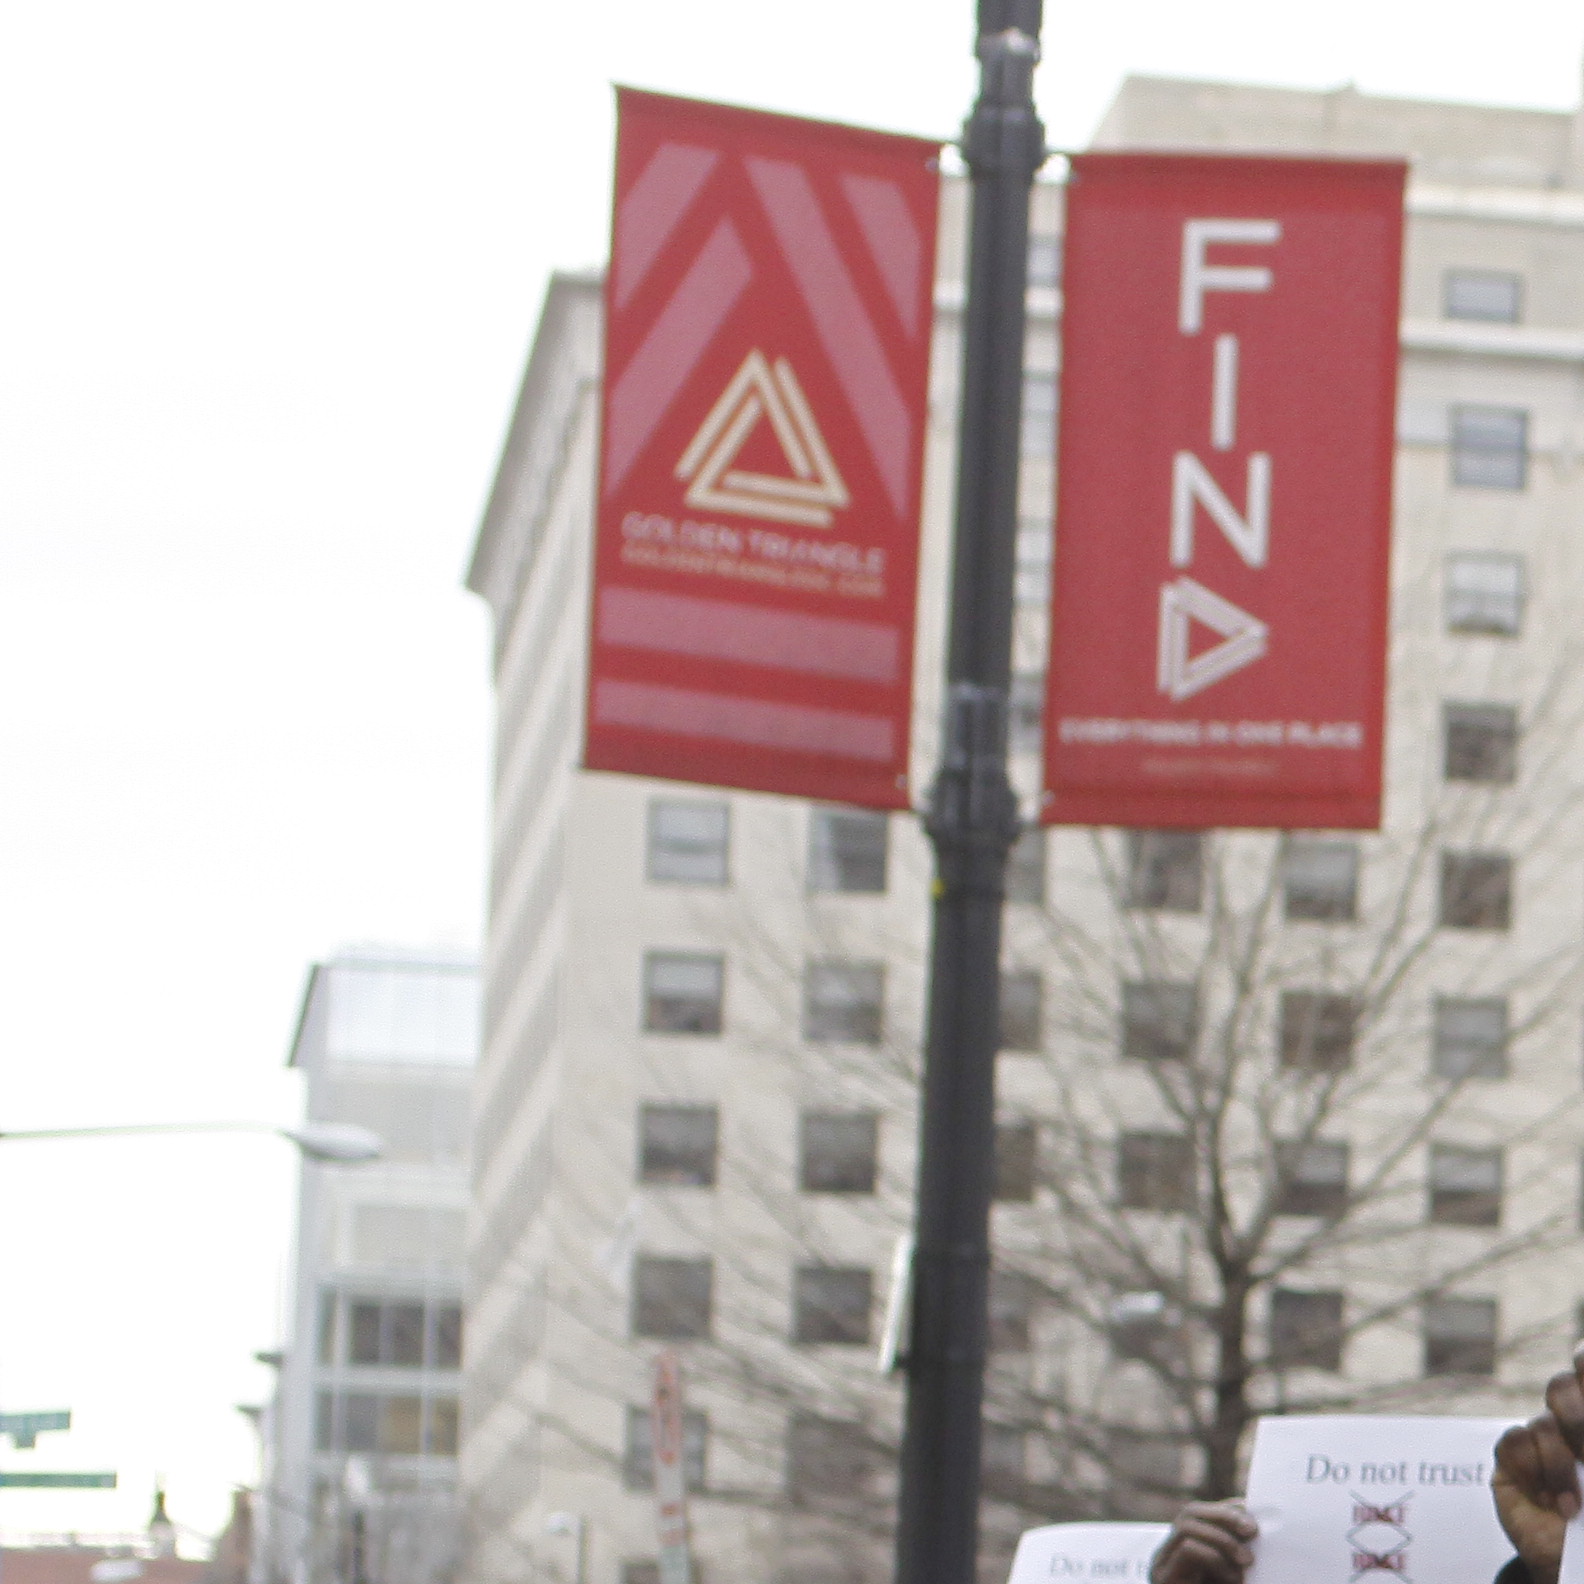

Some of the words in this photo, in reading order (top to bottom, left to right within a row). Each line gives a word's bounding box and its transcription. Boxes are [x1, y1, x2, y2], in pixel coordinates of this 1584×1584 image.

[1306, 1455, 1351, 1483] Do
[1360, 1461, 1408, 1485] not
[1418, 1461, 1484, 1486] trust
[1050, 1556, 1084, 1576] Do
[1090, 1557, 1127, 1576] not
